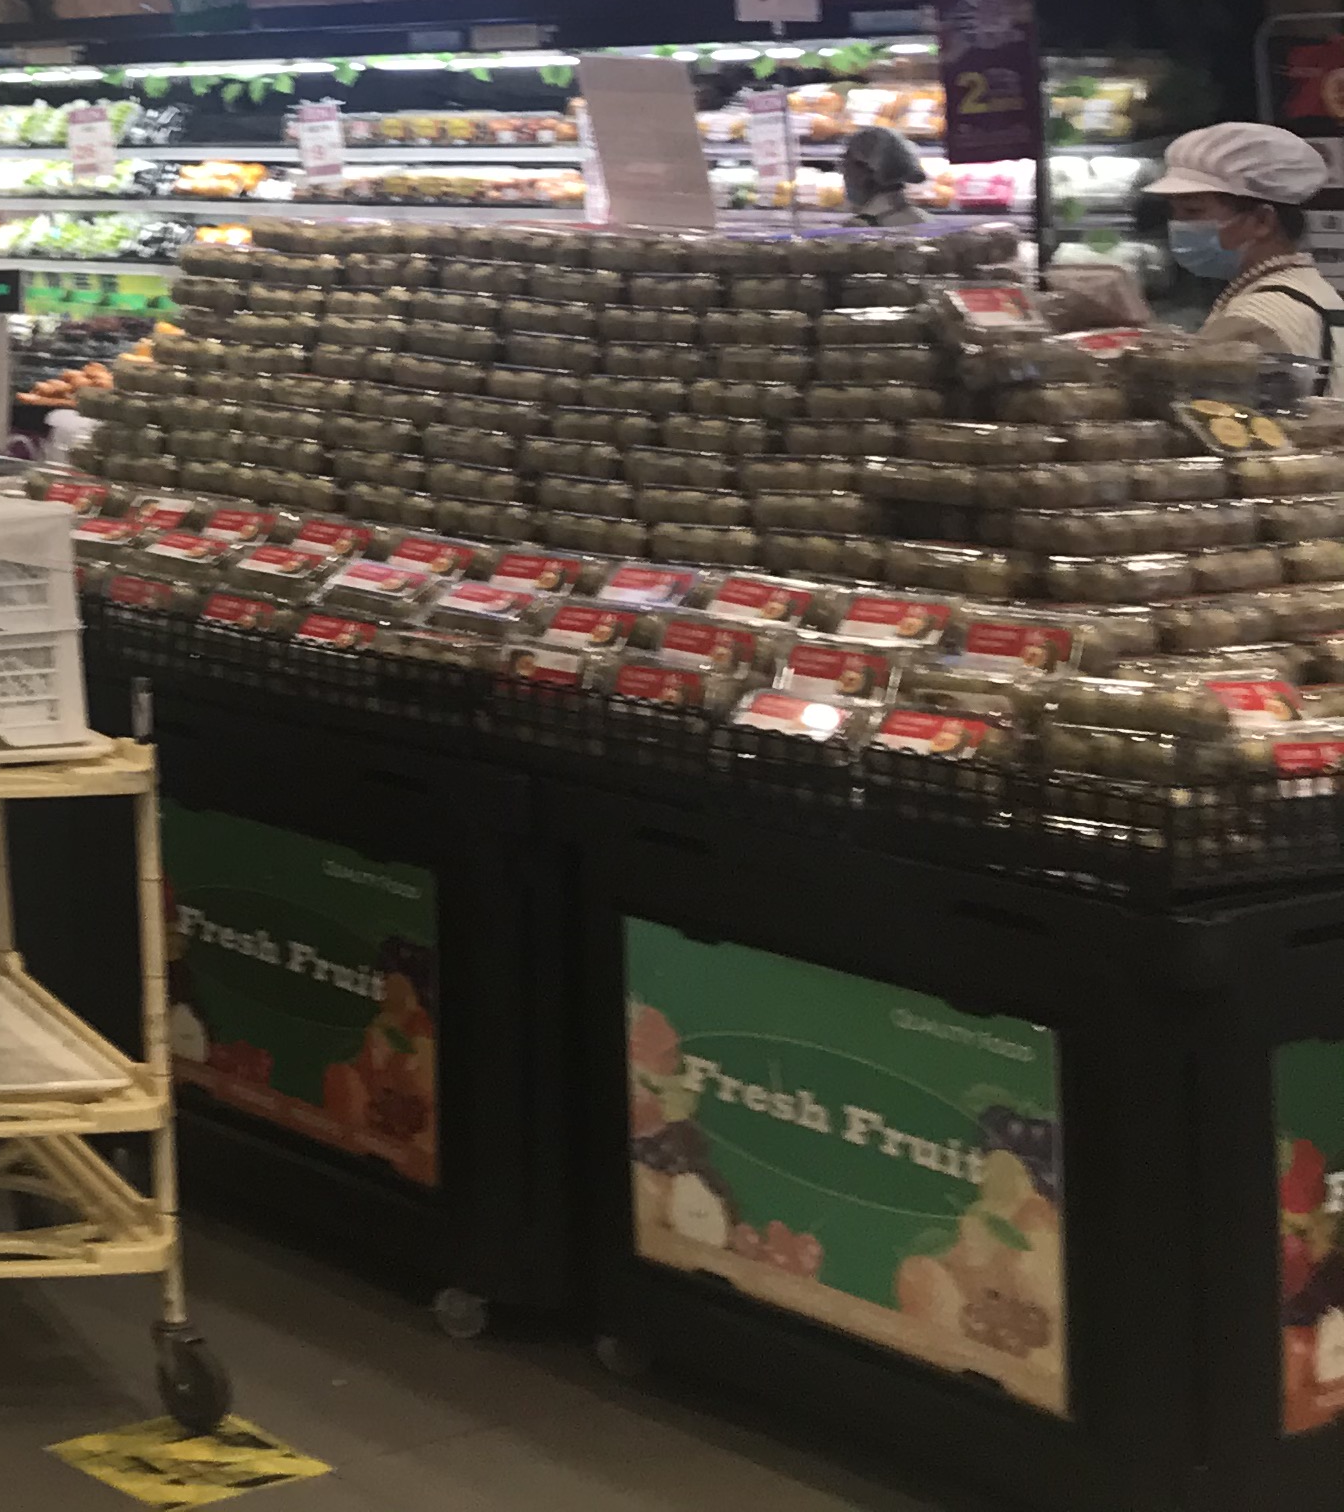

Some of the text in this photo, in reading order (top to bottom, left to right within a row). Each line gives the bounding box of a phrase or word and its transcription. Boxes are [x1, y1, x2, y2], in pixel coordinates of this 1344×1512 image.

[176, 904, 387, 1002] Fresh Fruit
[680, 1054, 986, 1186] Fresh Fruit
